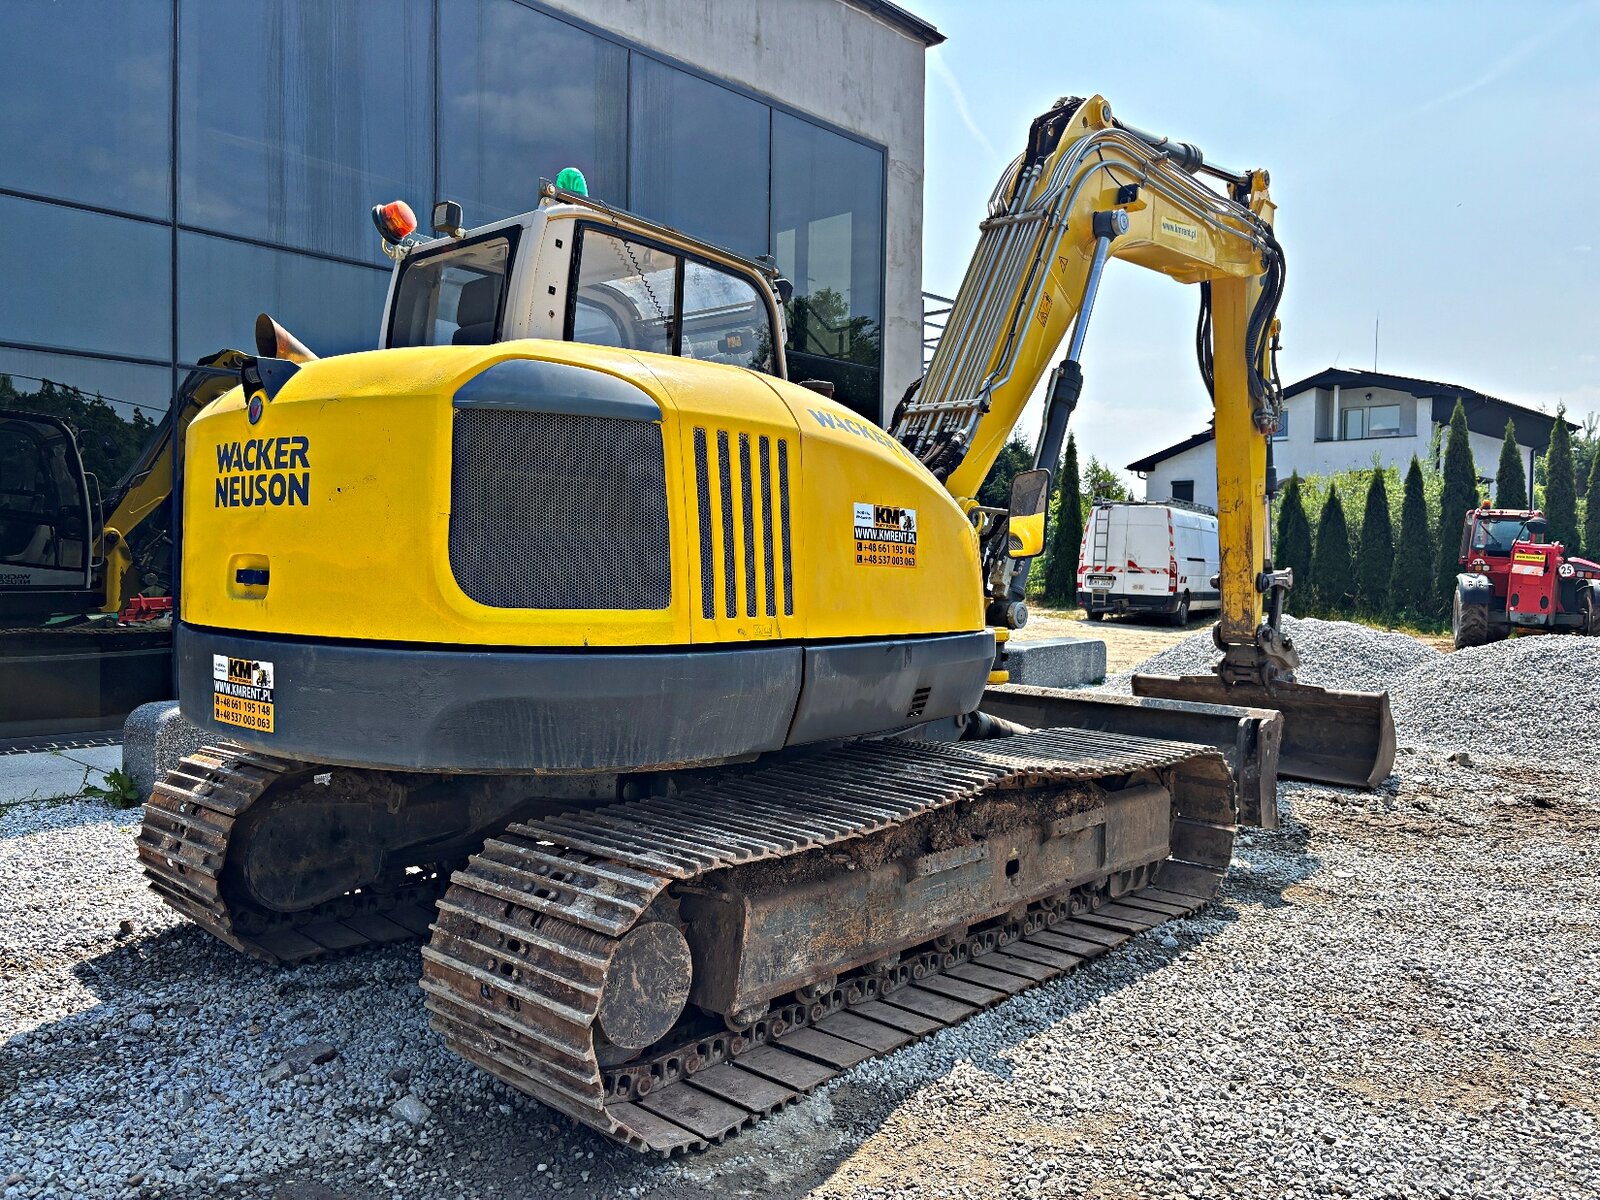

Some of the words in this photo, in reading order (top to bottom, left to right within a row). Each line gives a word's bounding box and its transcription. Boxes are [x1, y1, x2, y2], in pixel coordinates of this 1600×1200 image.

[807, 408, 900, 454] WACKER
[216, 435, 310, 474] WACKER
[215, 472, 310, 508] NEUSON
[875, 506, 900, 525] KM
[854, 527, 916, 544] WWW.KMRENT.PL
[863, 543, 877, 552] +48
[878, 544, 890, 553] 661
[892, 545, 903, 554] 195
[904, 546, 915, 555] 148
[863, 555, 877, 564] +48
[878, 555, 890, 565] 537
[892, 556, 903, 565] 003
[904, 557, 915, 566] 063
[1560, 566, 1572, 575] 25
[229, 659, 252, 679] KM
[214, 680, 273, 702] WWW.KMRENT.PL
[220, 698, 230, 708] +48
[231, 699, 242, 710] 661
[244, 702, 256, 713] 195
[257, 704, 271, 716] 148
[220, 710, 230, 720] +48
[231, 711, 242, 722] 537
[243, 714, 256, 726] 003
[257, 717, 270, 729] 063
